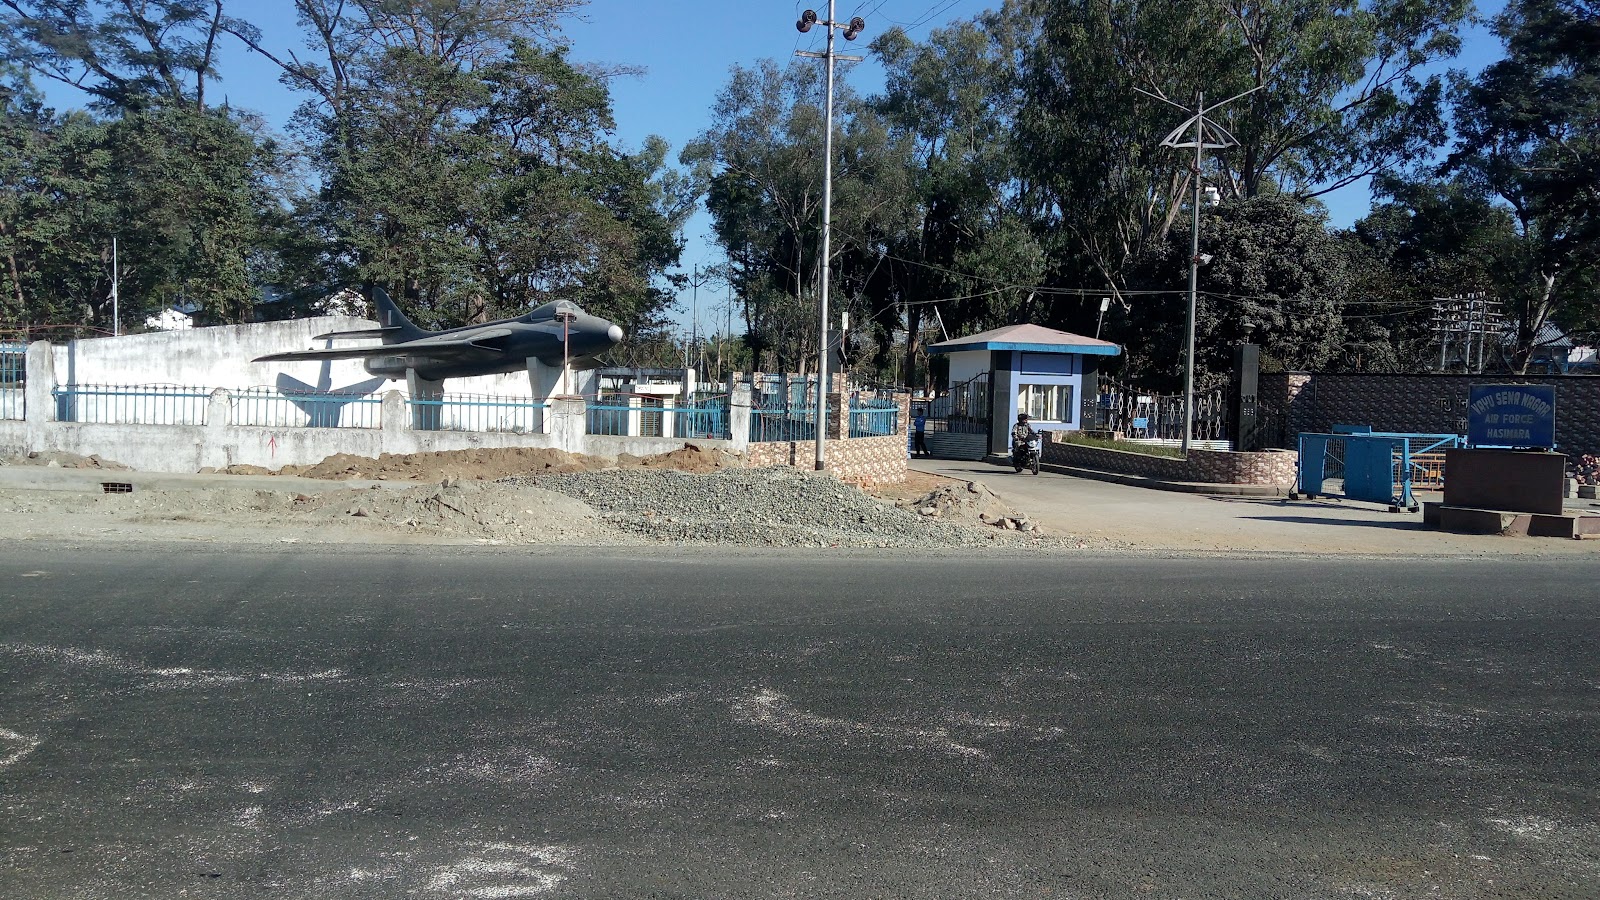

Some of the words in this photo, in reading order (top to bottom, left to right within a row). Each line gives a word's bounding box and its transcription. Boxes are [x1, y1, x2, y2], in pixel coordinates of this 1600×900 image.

[1471, 394, 1495, 415] VAYU
[1496, 391, 1521, 405] SENA
[1521, 393, 1551, 416] NAGAR
[1485, 414, 1499, 424] AIR
[1503, 414, 1534, 424] FORCE
[1487, 428, 1530, 439] HASIMARA
